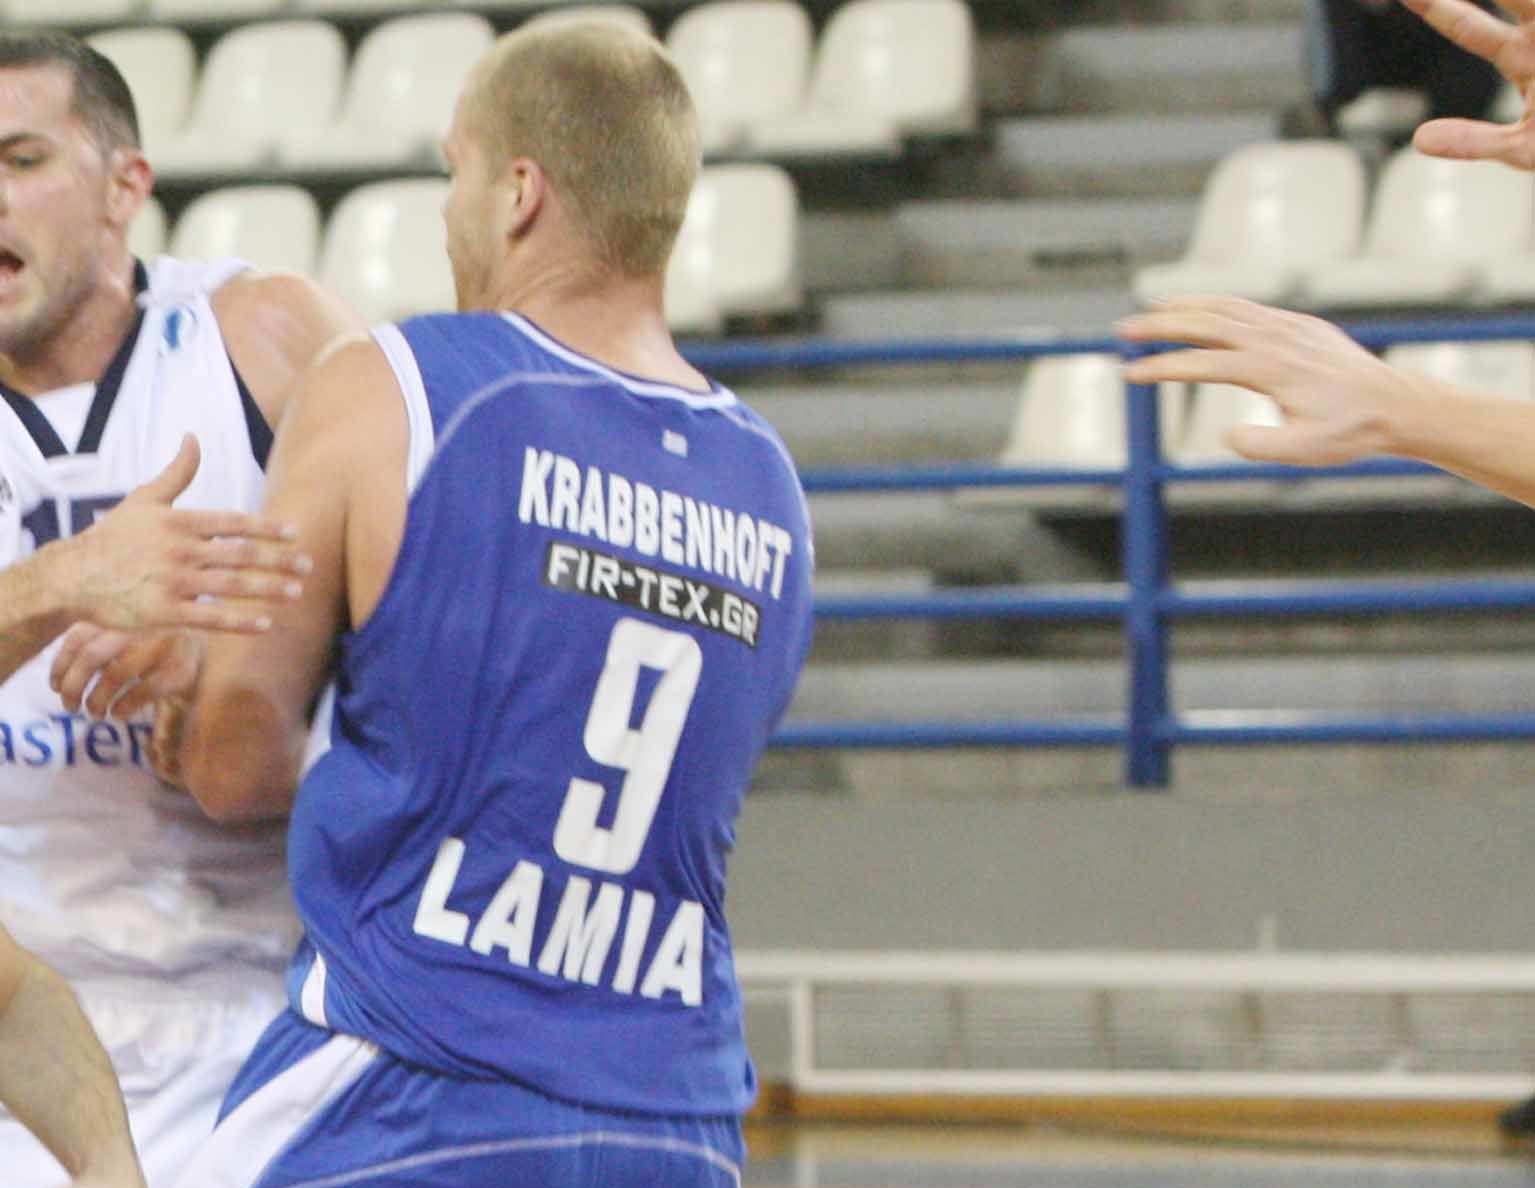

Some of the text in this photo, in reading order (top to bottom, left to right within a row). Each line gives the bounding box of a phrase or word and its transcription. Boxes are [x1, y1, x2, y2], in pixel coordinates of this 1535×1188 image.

[518, 446, 792, 600] KRABBENHOFT
[547, 543, 760, 646] FIR-TEX.GR
[553, 617, 703, 875] 9
[413, 838, 705, 1007] LAMIA
